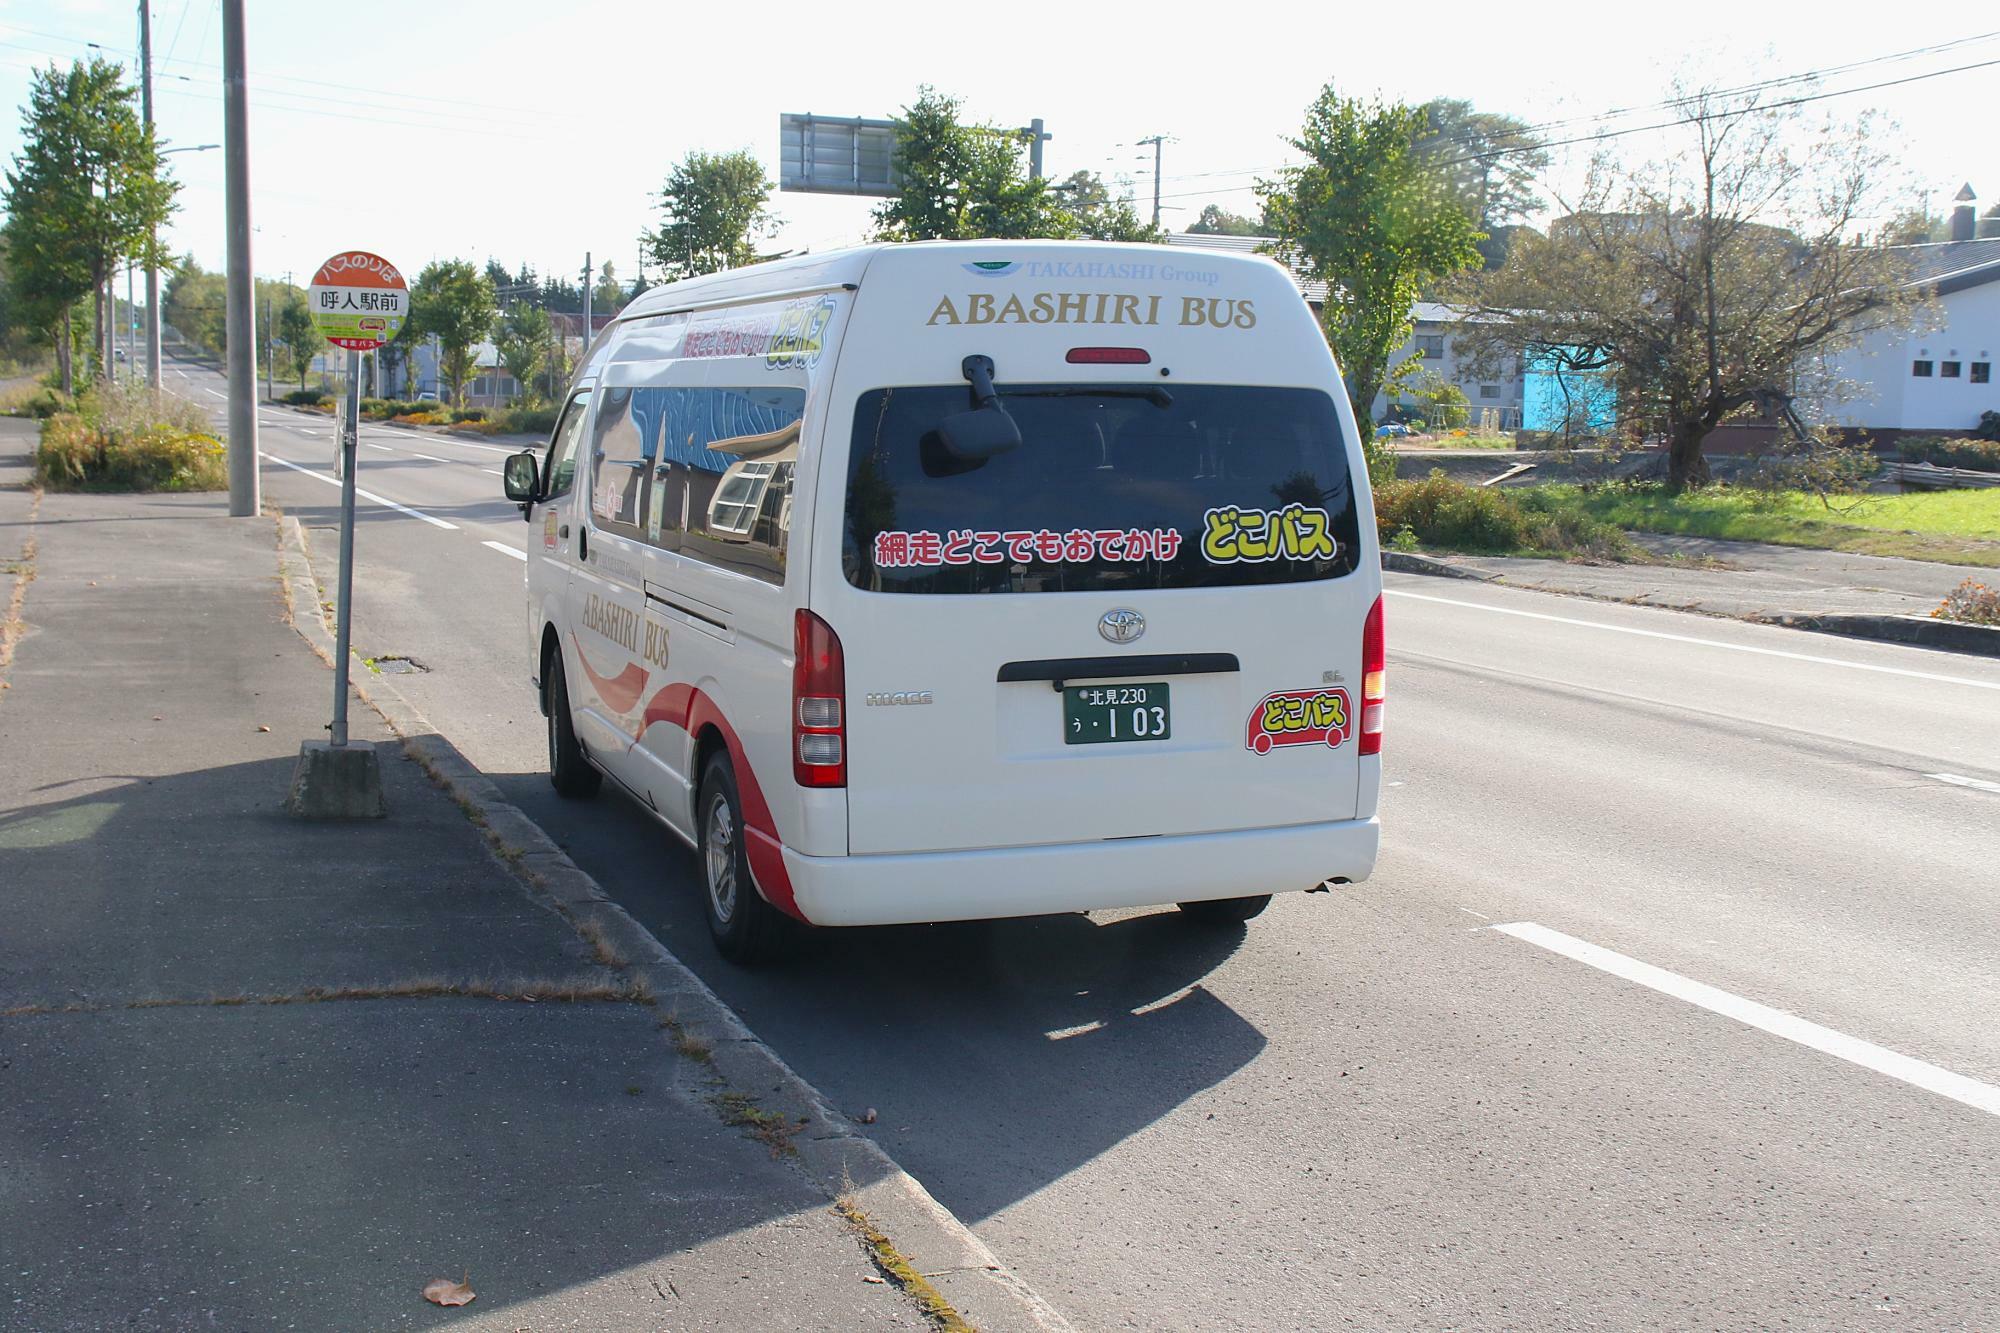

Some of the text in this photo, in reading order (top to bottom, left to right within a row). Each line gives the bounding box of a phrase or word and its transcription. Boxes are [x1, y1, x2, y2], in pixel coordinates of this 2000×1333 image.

[321, 254, 401, 284] バスのりば
[1026, 261, 1220, 286] TAKAHASHI Group
[321, 291, 399, 311] 呼人駅前
[925, 292, 1257, 330] ABASHIRI BUS
[875, 504, 1336, 566] 網走どこでもおでかけ どこバス
[582, 592, 670, 671] ABASHIRI BUS
[866, 690, 934, 706] HIACE
[1262, 694, 1345, 733] どこバス
